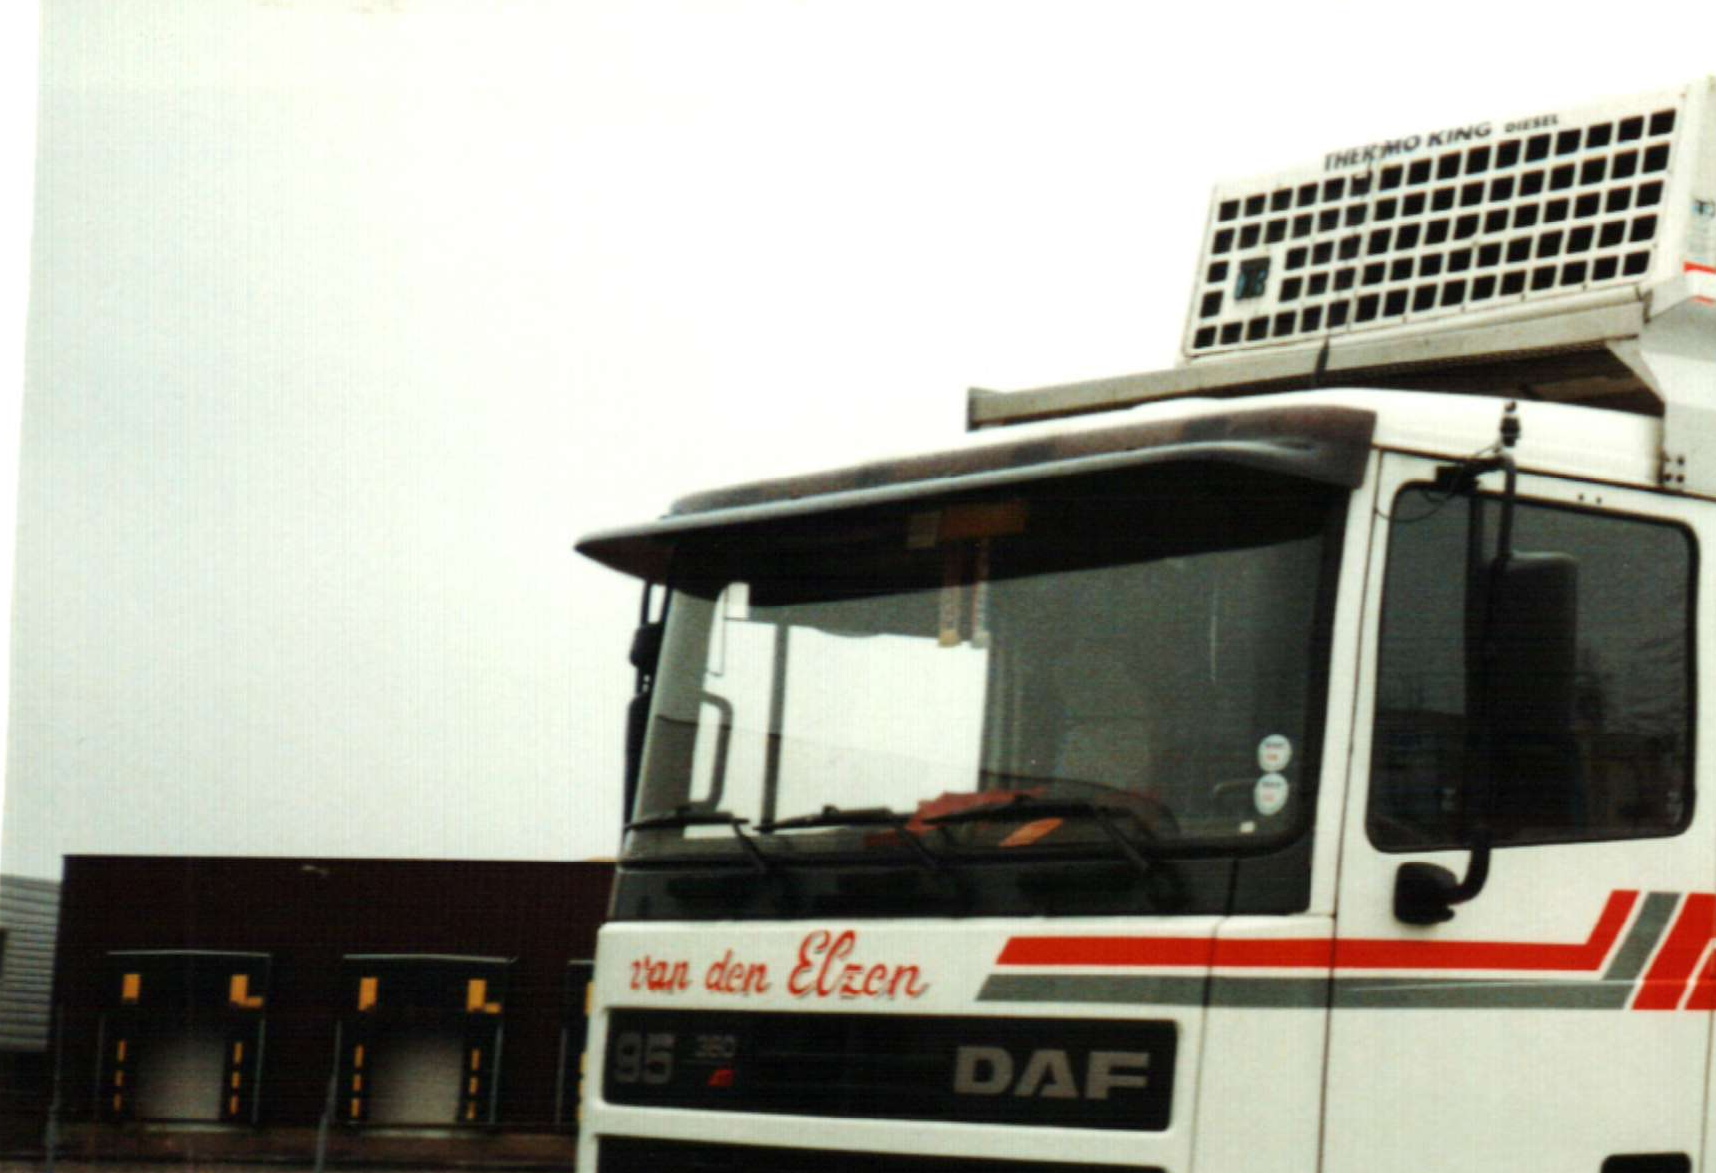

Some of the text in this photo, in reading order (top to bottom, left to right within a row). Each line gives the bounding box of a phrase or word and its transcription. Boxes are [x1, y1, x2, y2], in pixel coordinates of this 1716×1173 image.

[1427, 121, 1492, 147] KING
[1504, 113, 1559, 133] DIESEL
[630, 929, 930, 999] van den Elzen
[614, 1033, 675, 1085] 95
[953, 1045, 1150, 1100] DAF
